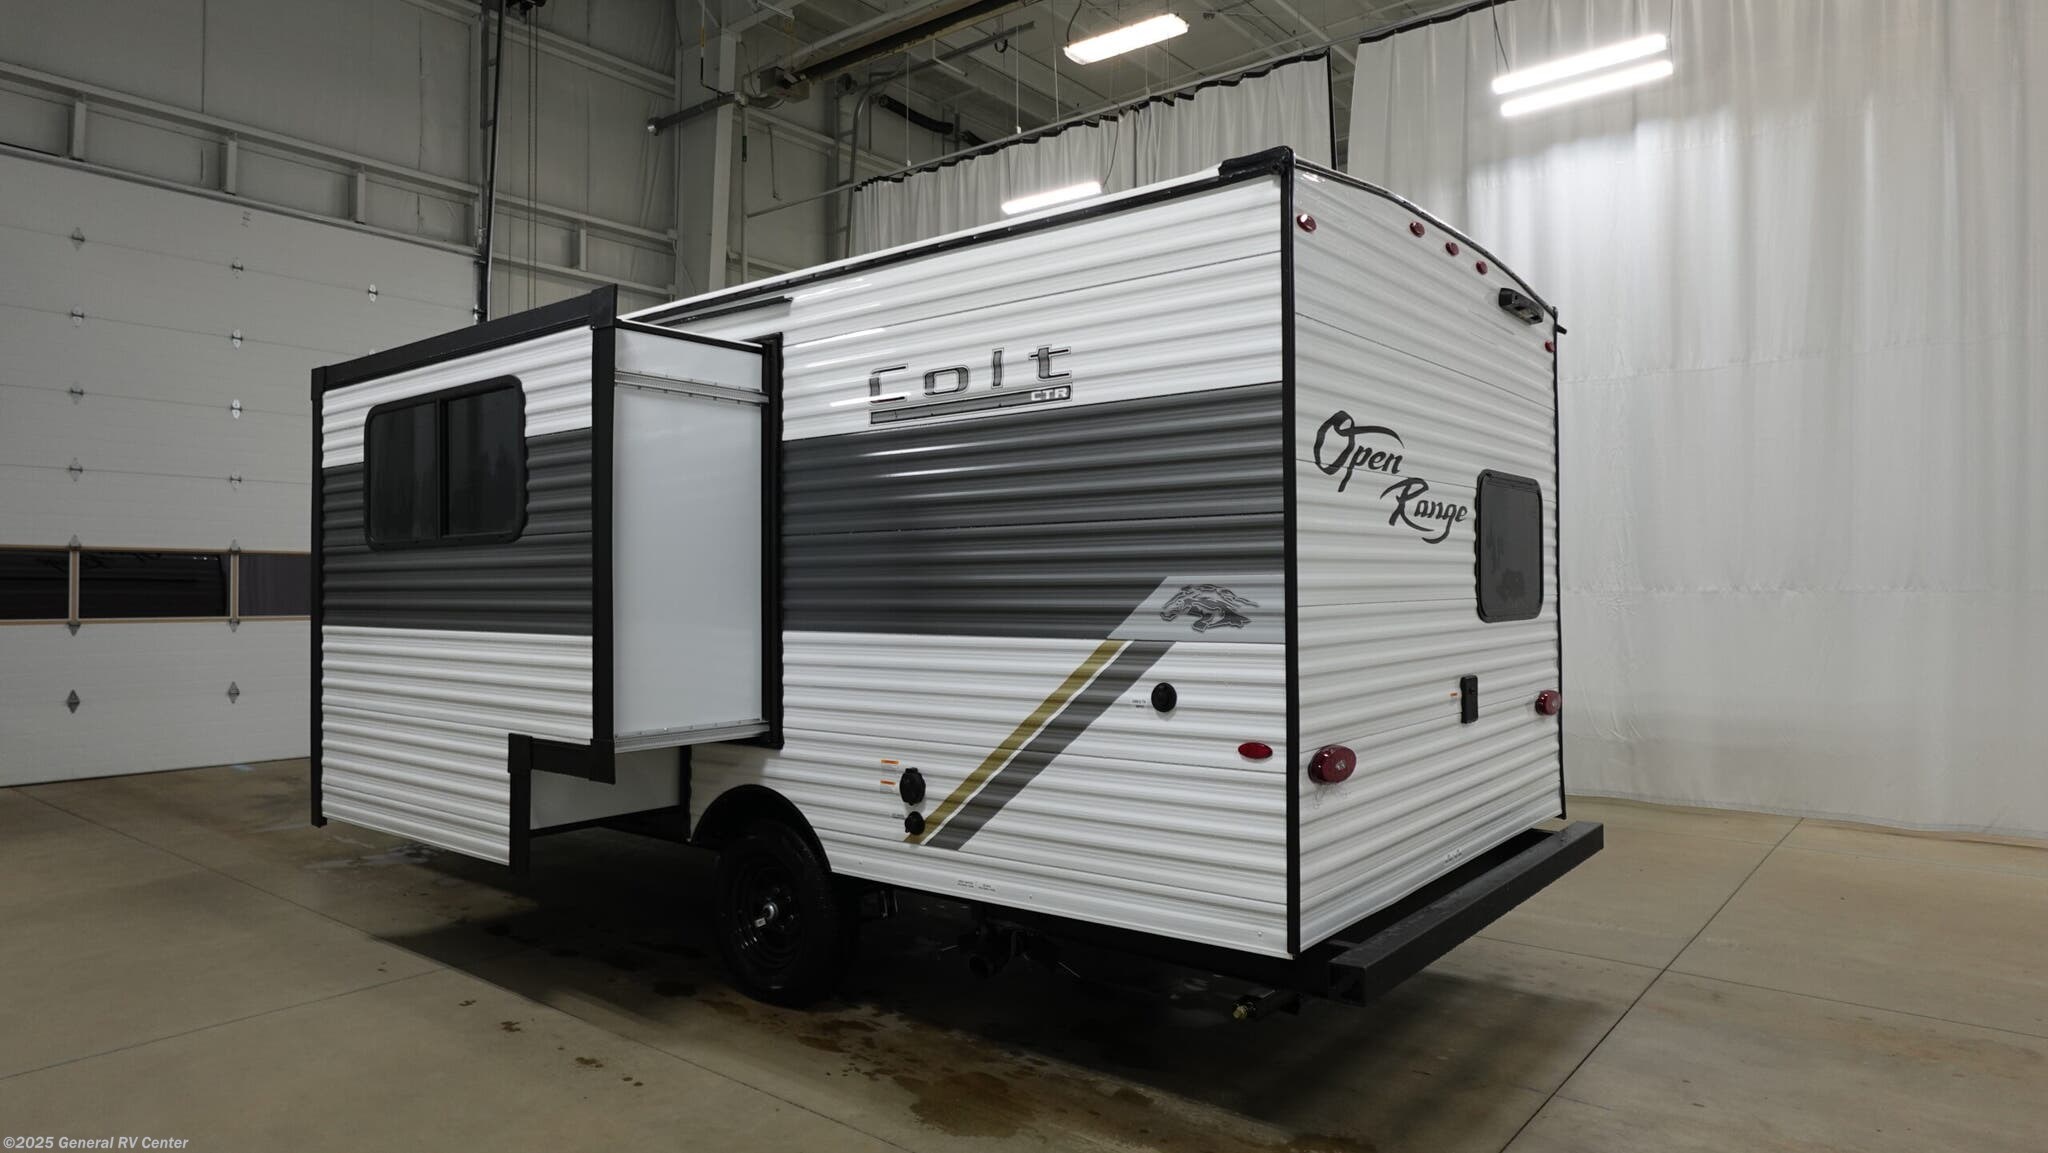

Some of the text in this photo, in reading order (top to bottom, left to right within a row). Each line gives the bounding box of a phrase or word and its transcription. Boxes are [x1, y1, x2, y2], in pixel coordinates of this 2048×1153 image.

[868, 344, 1071, 403] Colt
[1031, 387, 1069, 401] CTR
[1313, 410, 1405, 492] Open
[1380, 477, 1468, 544] Range
